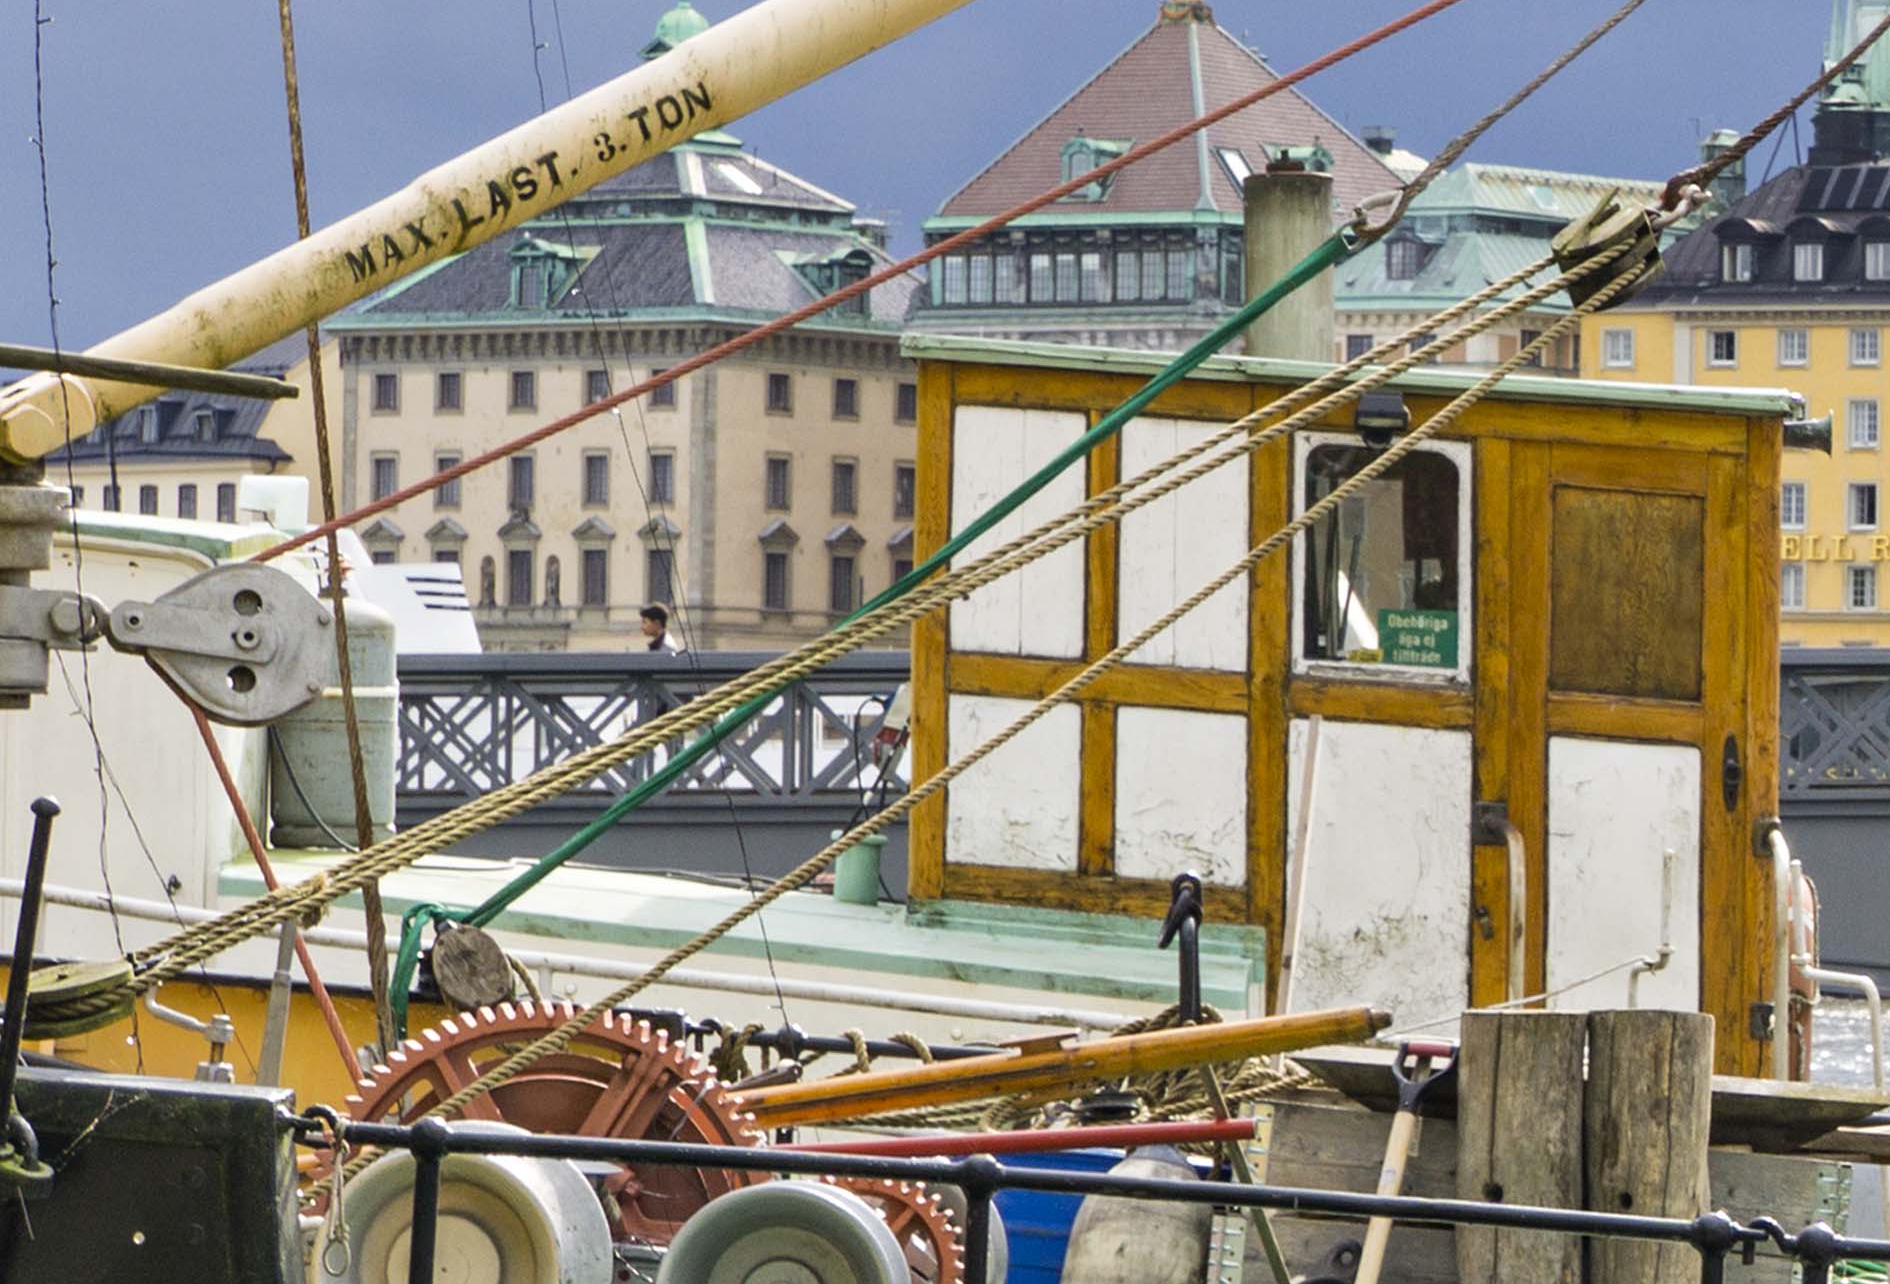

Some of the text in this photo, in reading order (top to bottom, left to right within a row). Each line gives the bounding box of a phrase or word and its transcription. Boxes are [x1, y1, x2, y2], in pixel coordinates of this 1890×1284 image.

[628, 81, 713, 142] TON
[1387, 613, 1448, 632] Obehöriga
[1398, 632, 1436, 648] äga ej
[1392, 648, 1441, 663] tillträde
